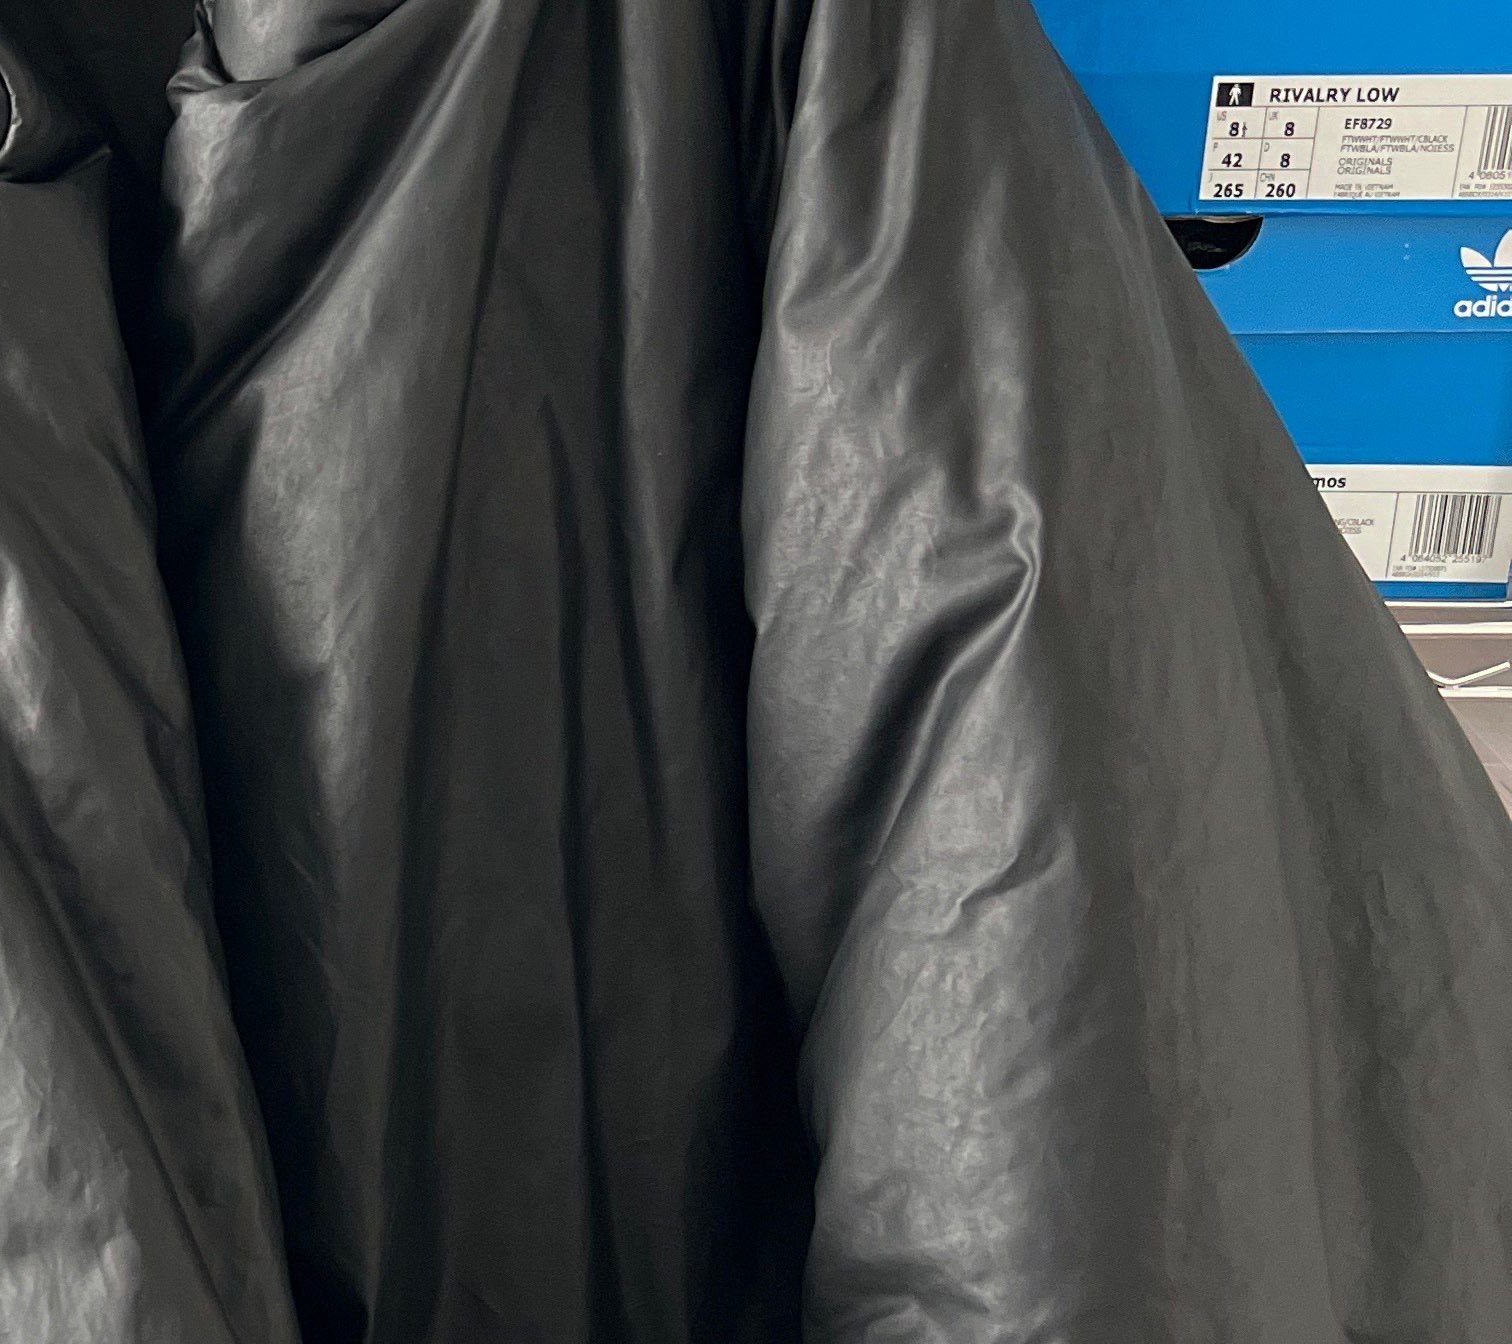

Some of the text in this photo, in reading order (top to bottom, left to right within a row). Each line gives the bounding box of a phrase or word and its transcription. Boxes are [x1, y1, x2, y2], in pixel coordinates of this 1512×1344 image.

[1269, 87, 1400, 103] RIVALRY LOW
[1284, 122, 1294, 136] 8
[1344, 118, 1392, 130] EF8729
[1222, 153, 1242, 168] 42
[1280, 153, 1290, 168] 8
[1214, 184, 1243, 198] 265
[1266, 183, 1296, 198] 260
[1453, 295, 1512, 317] adid
[1312, 477, 1346, 488] mos
